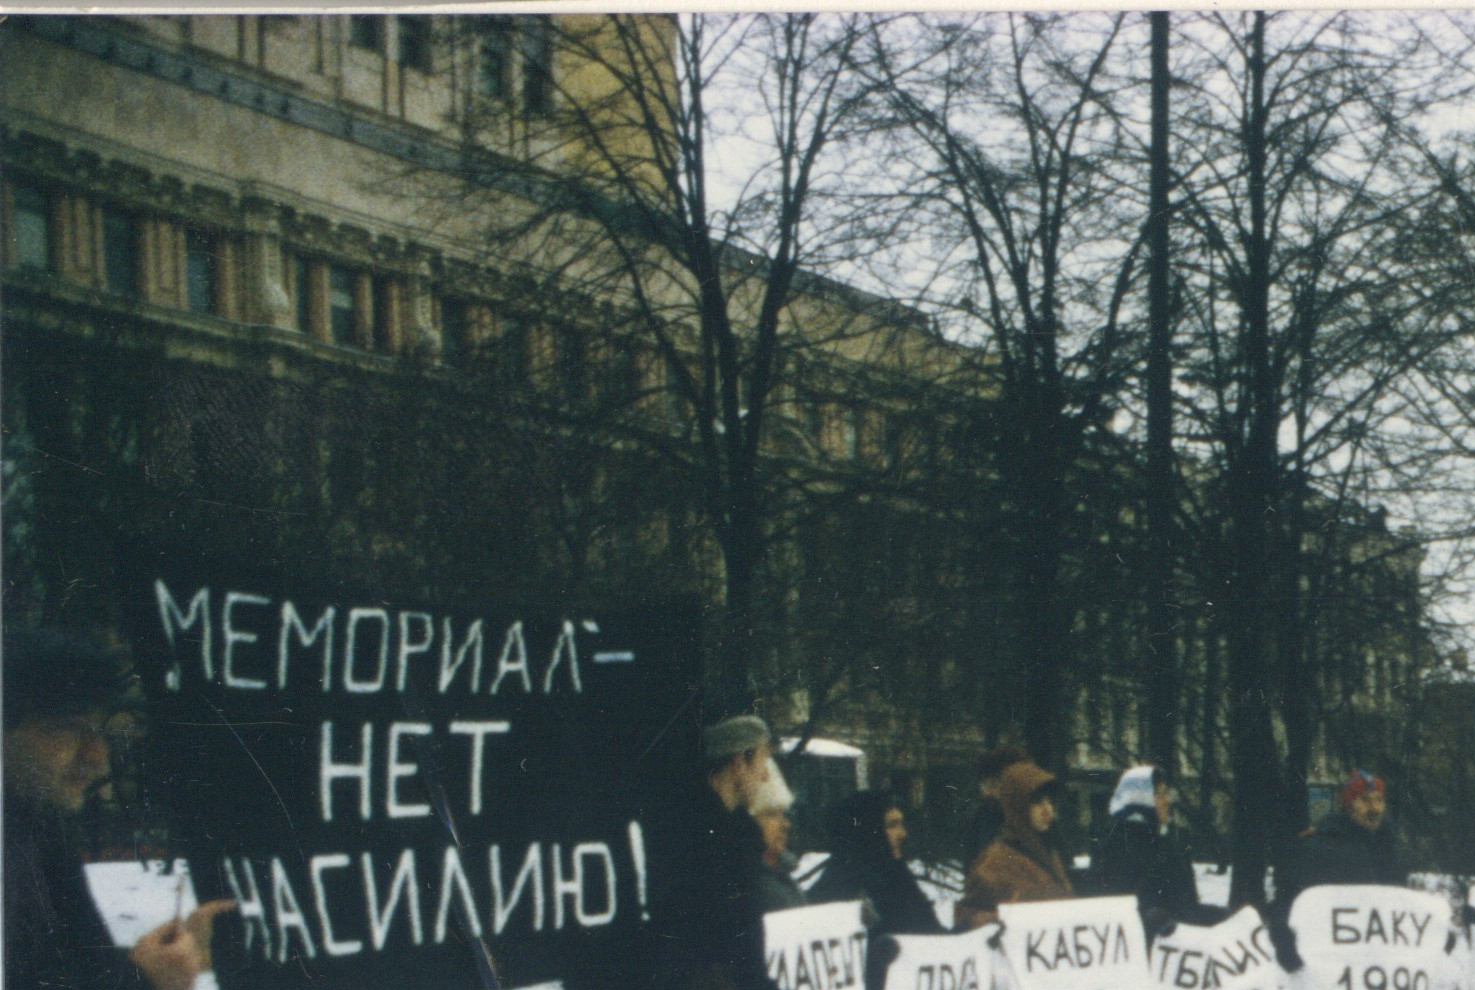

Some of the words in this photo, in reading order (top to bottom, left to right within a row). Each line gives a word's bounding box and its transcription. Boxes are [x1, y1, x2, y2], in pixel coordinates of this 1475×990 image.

[319, 720, 511, 821] НЕТ
[223, 820, 650, 963] НАСИЛИЮ!
[1331, 908, 1433, 947] БАКУ
[1026, 922, 1130, 973] КАБУЛ
